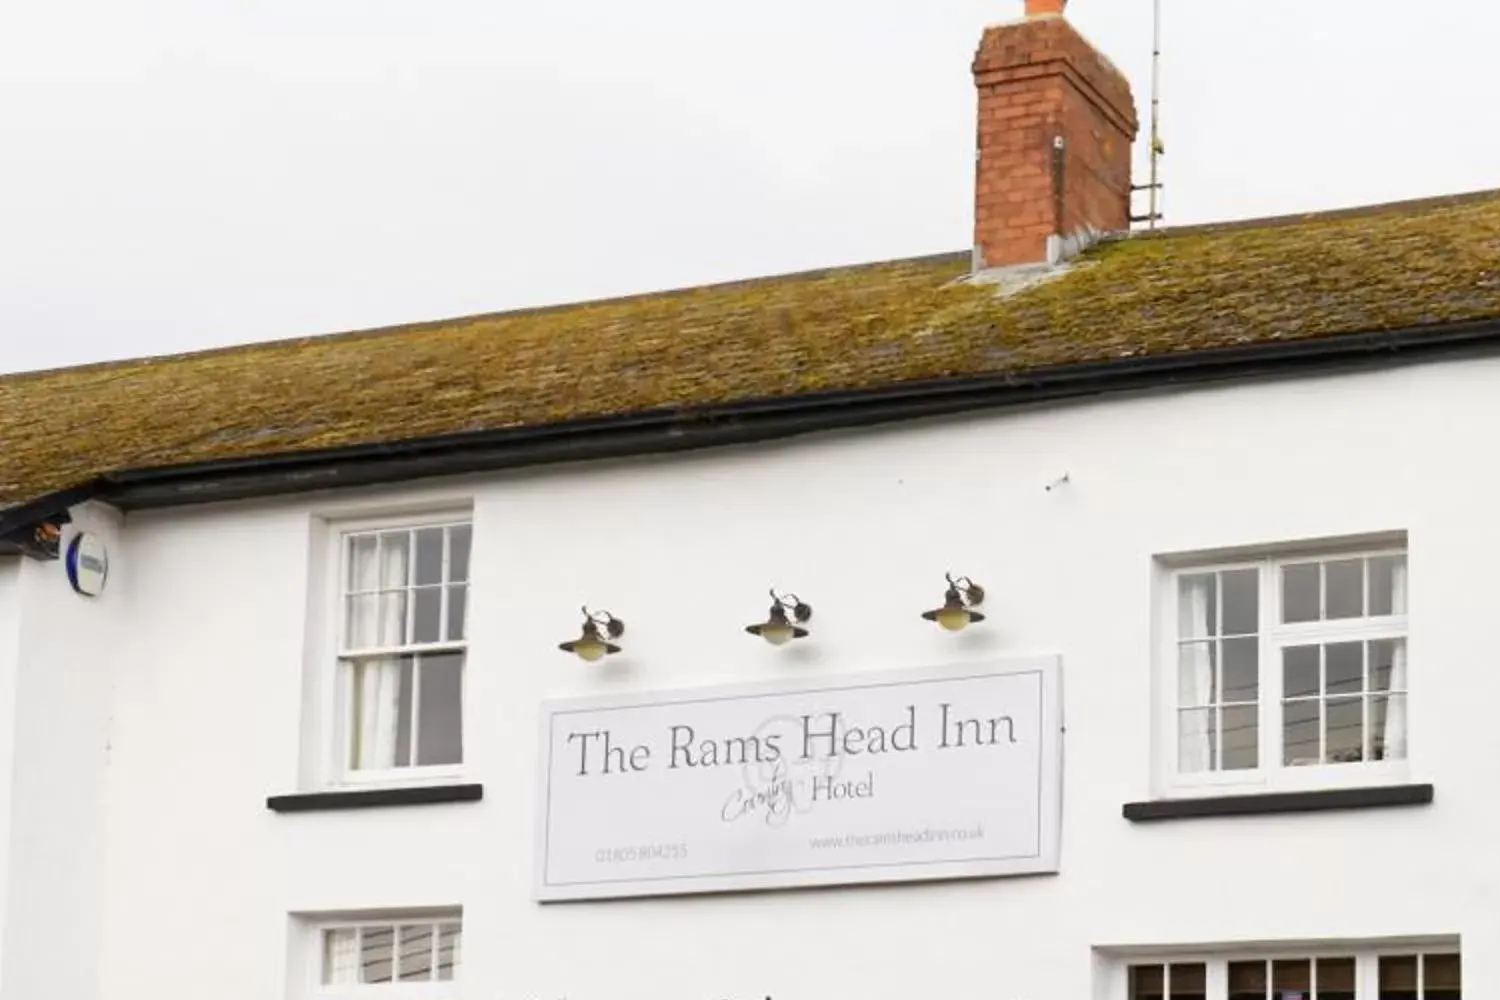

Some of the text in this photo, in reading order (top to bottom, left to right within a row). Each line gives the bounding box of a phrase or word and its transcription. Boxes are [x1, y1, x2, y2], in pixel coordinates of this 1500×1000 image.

[569, 704, 1017, 775] The Rams Head Inn
[811, 771, 874, 802] Hotel
